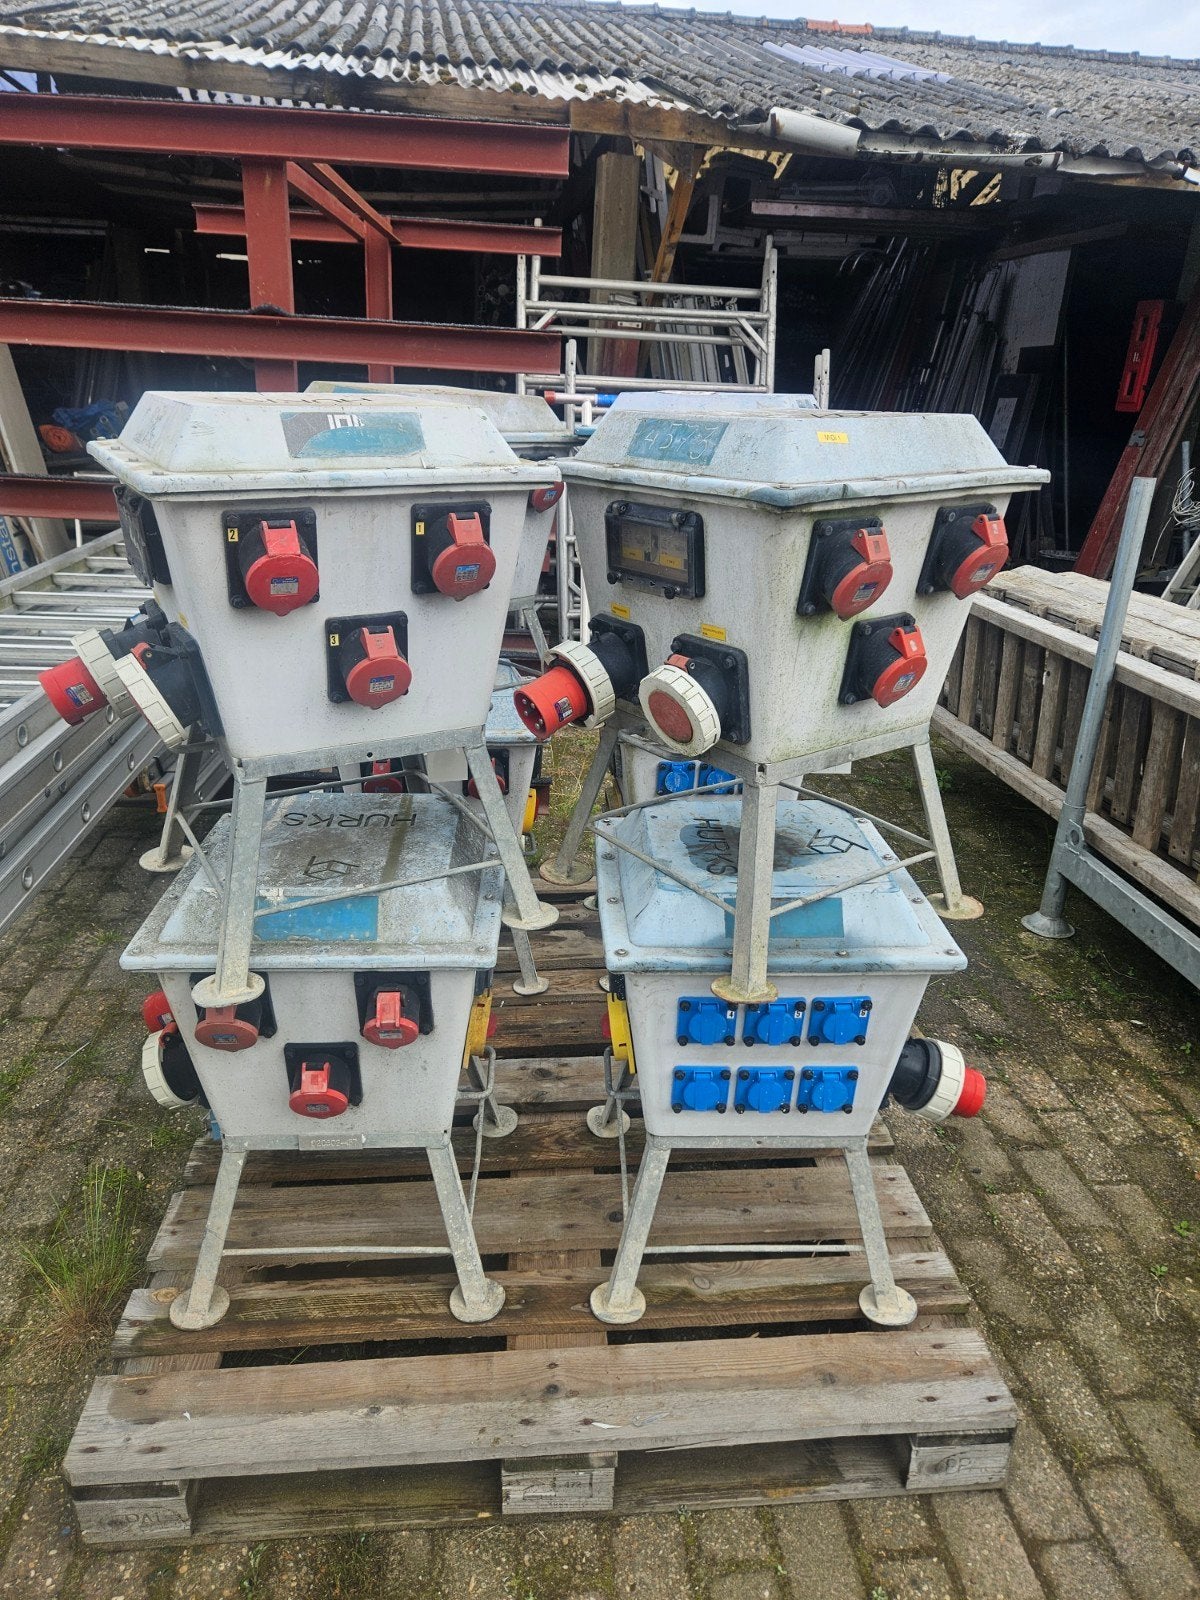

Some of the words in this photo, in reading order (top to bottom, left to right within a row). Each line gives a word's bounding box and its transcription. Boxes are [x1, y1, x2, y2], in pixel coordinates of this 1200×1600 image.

[229, 529, 236, 540] 2
[331, 635, 336, 645] 3
[282, 812, 417, 828] HURKS
[692, 818, 739, 876] HURKS
